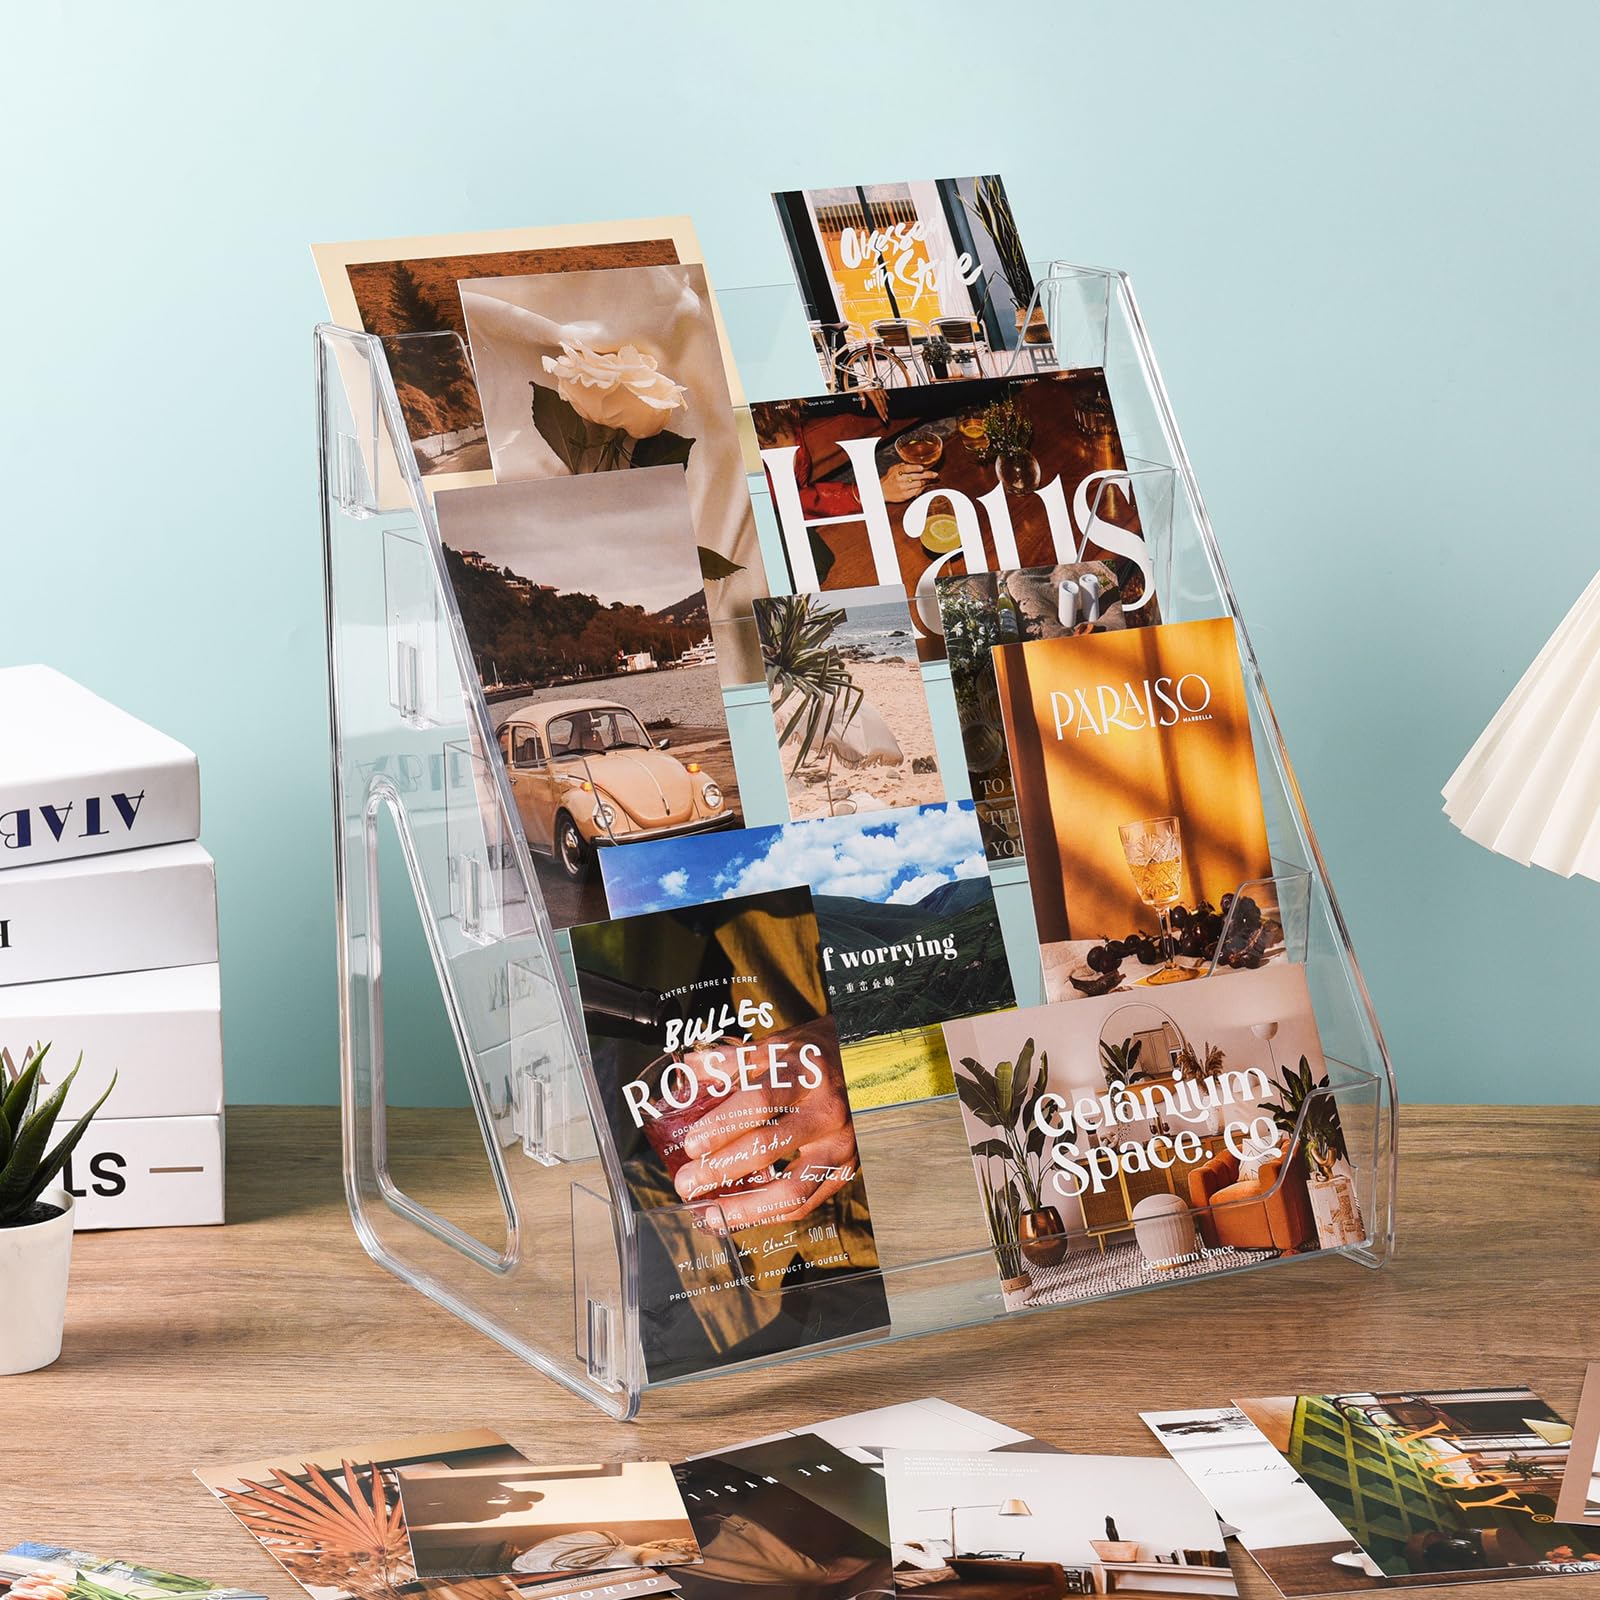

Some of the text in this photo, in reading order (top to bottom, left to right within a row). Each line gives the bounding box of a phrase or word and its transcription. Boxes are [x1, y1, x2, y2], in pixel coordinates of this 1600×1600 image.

[864, 260, 896, 299] with
[761, 437, 1155, 639] Haus
[1050, 673, 1211, 741] PARAISO
[1183, 714, 1213, 723] MARBELLA
[839, 933, 958, 967] worrying
[659, 975, 758, 1001] ENTRE PIERRE & TERRE
[663, 999, 774, 1053] BULLES
[621, 1033, 823, 1128] ROSÉES
[1034, 1067, 1274, 1137] Geranium
[663, 1118, 780, 1156] SPARKLING CIDER COCKTAIL
[672, 1105, 800, 1138] COCKTAIL AU CIDRE MOUSSEUX
[1051, 1129, 1213, 1197] Space.
[692, 1219, 708, 1229] LOT
[756, 1196, 807, 1214] BOUTEILLES
[753, 1213, 786, 1227] LIMITÉE
[808, 1227, 824, 1243] 500
[826, 1223, 839, 1239] mL
[1141, 1244, 1235, 1270] Geranium Space
[669, 1287, 707, 1301] PRODUIT
[710, 1283, 721, 1292] DU
[764, 1264, 802, 1277] PRODUCT
[805, 1261, 815, 1269] OF
[818, 1252, 849, 1266] QUÉBEC
